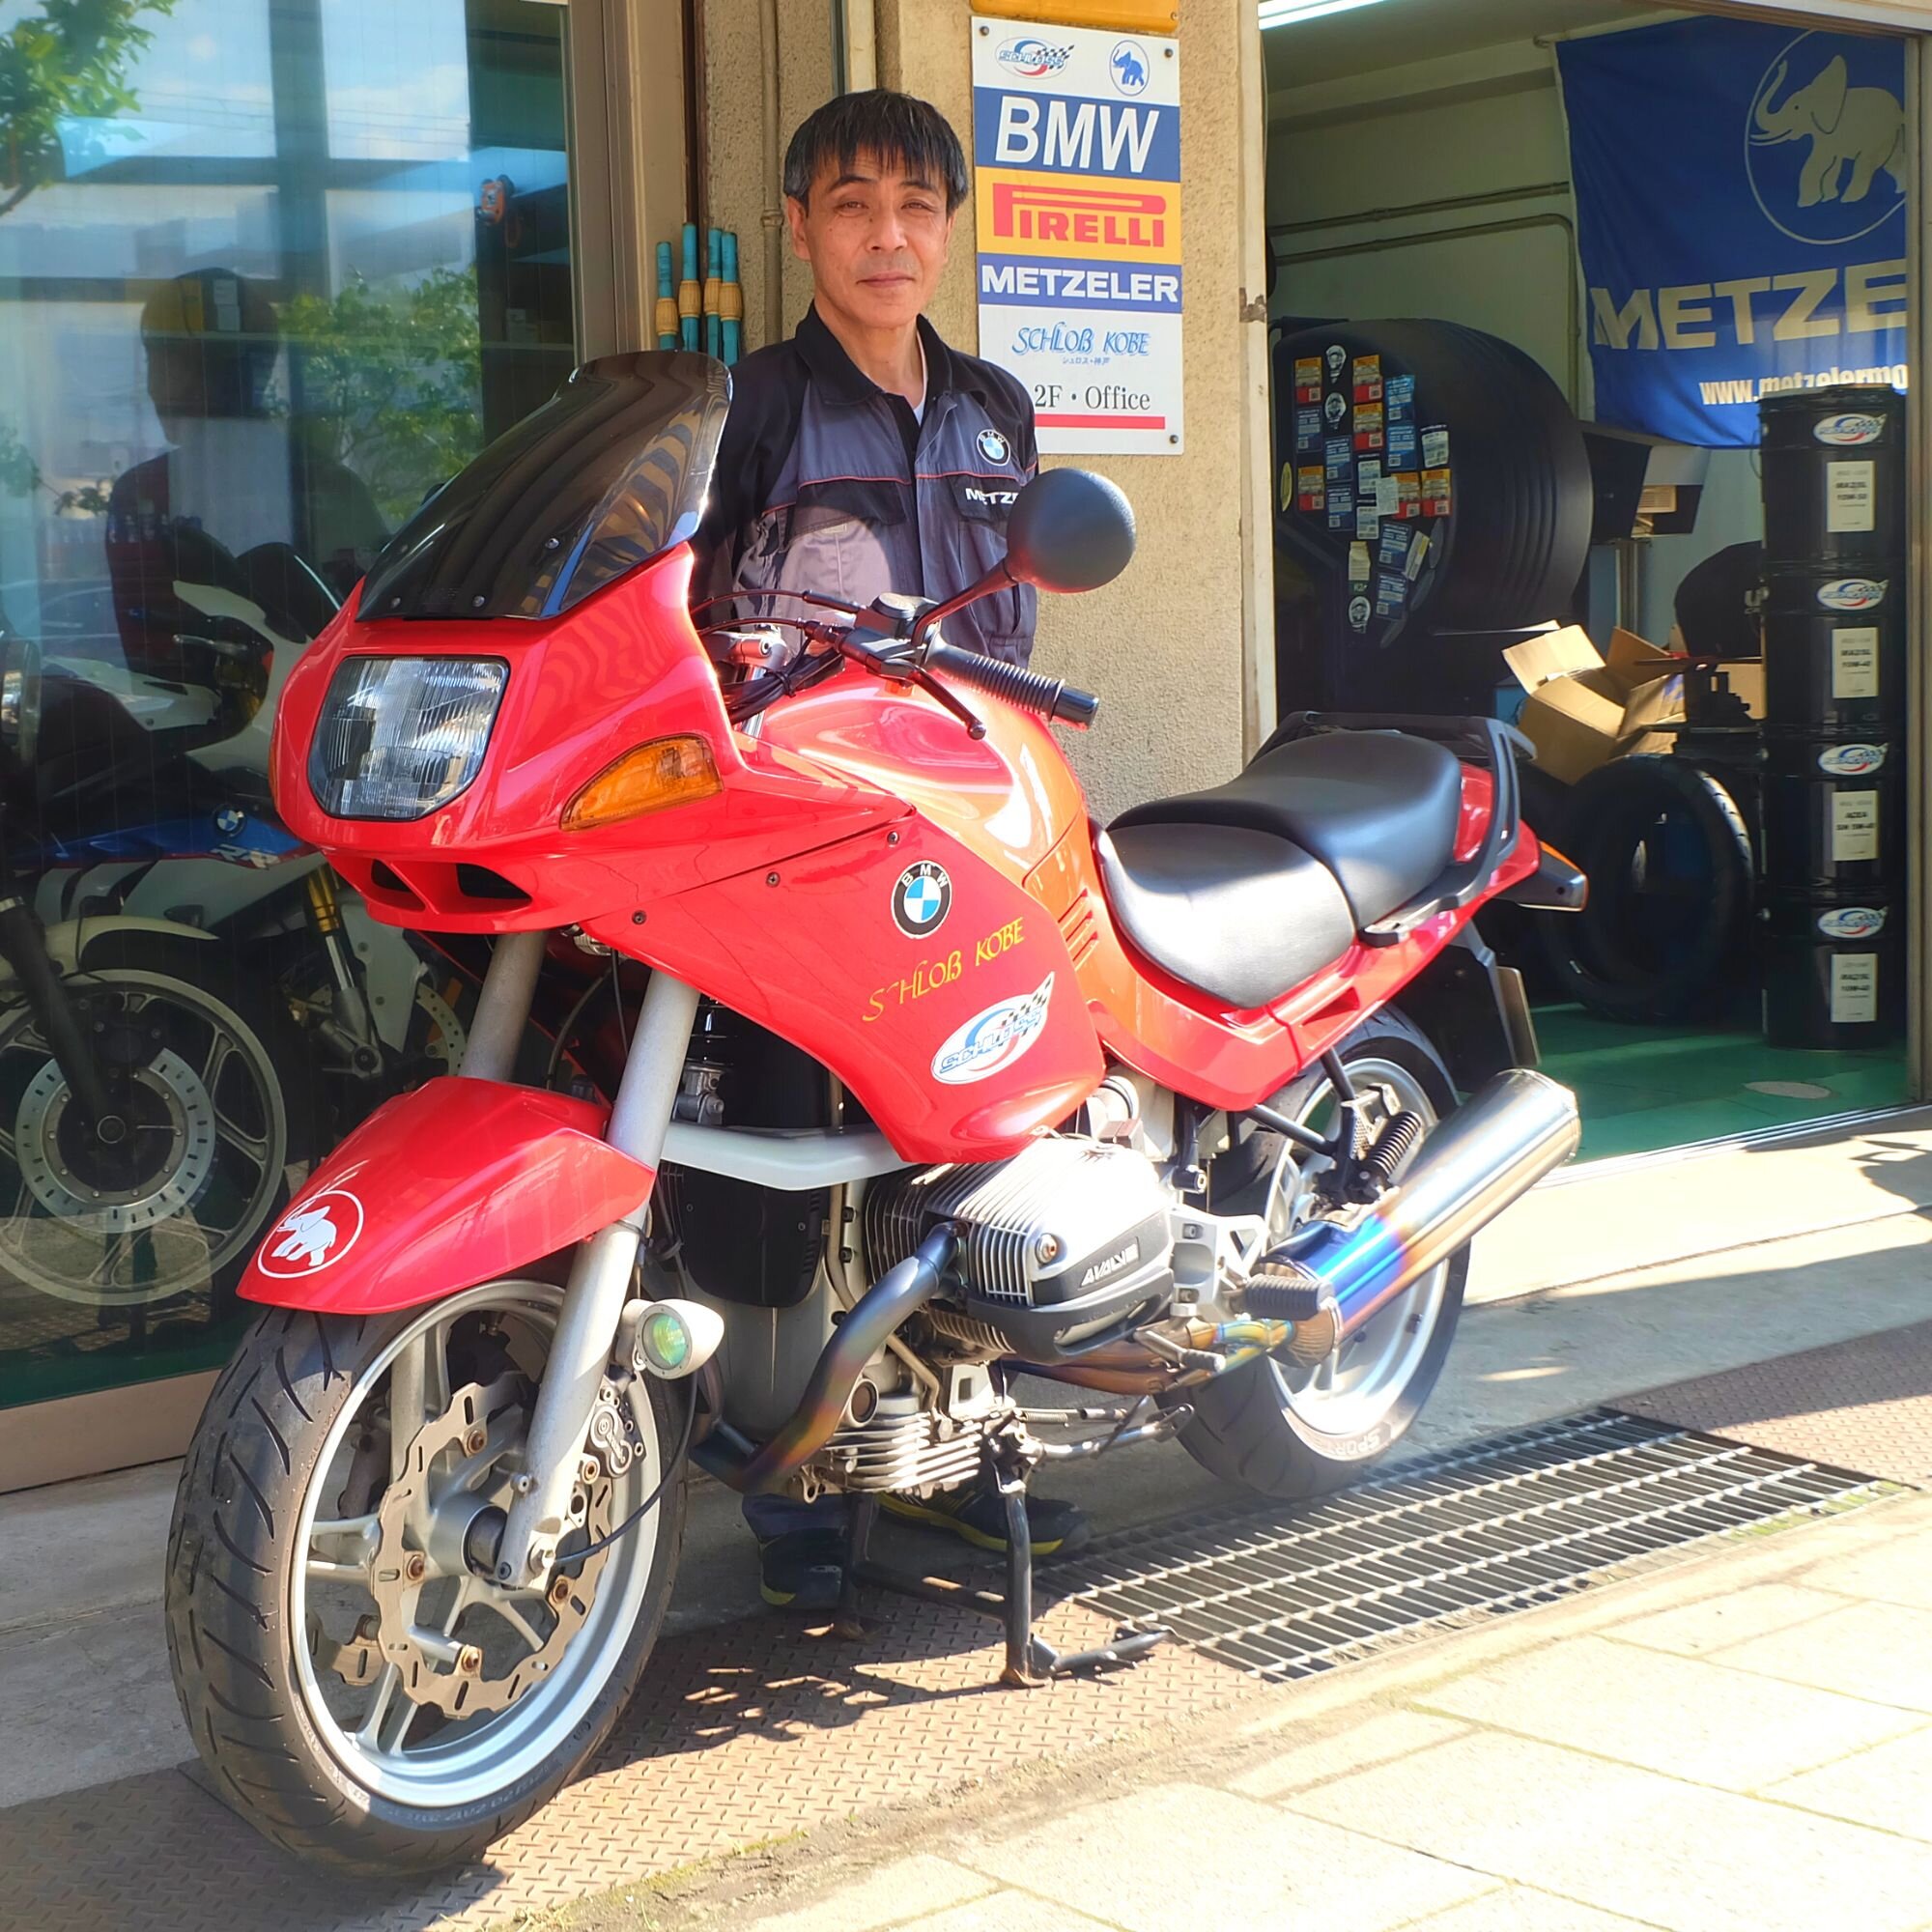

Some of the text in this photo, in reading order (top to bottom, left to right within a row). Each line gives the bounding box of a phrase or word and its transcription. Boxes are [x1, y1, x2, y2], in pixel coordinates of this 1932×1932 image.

[995, 96, 1159, 174] BMW
[993, 183, 1167, 247] PIRELLI
[981, 265, 1179, 302] METZELER
[1103, 330, 1151, 355] KOBE
[1034, 384, 1151, 411] 2F Office
[901, 863, 949, 889] BMW
[975, 917, 1025, 967] KOBE
